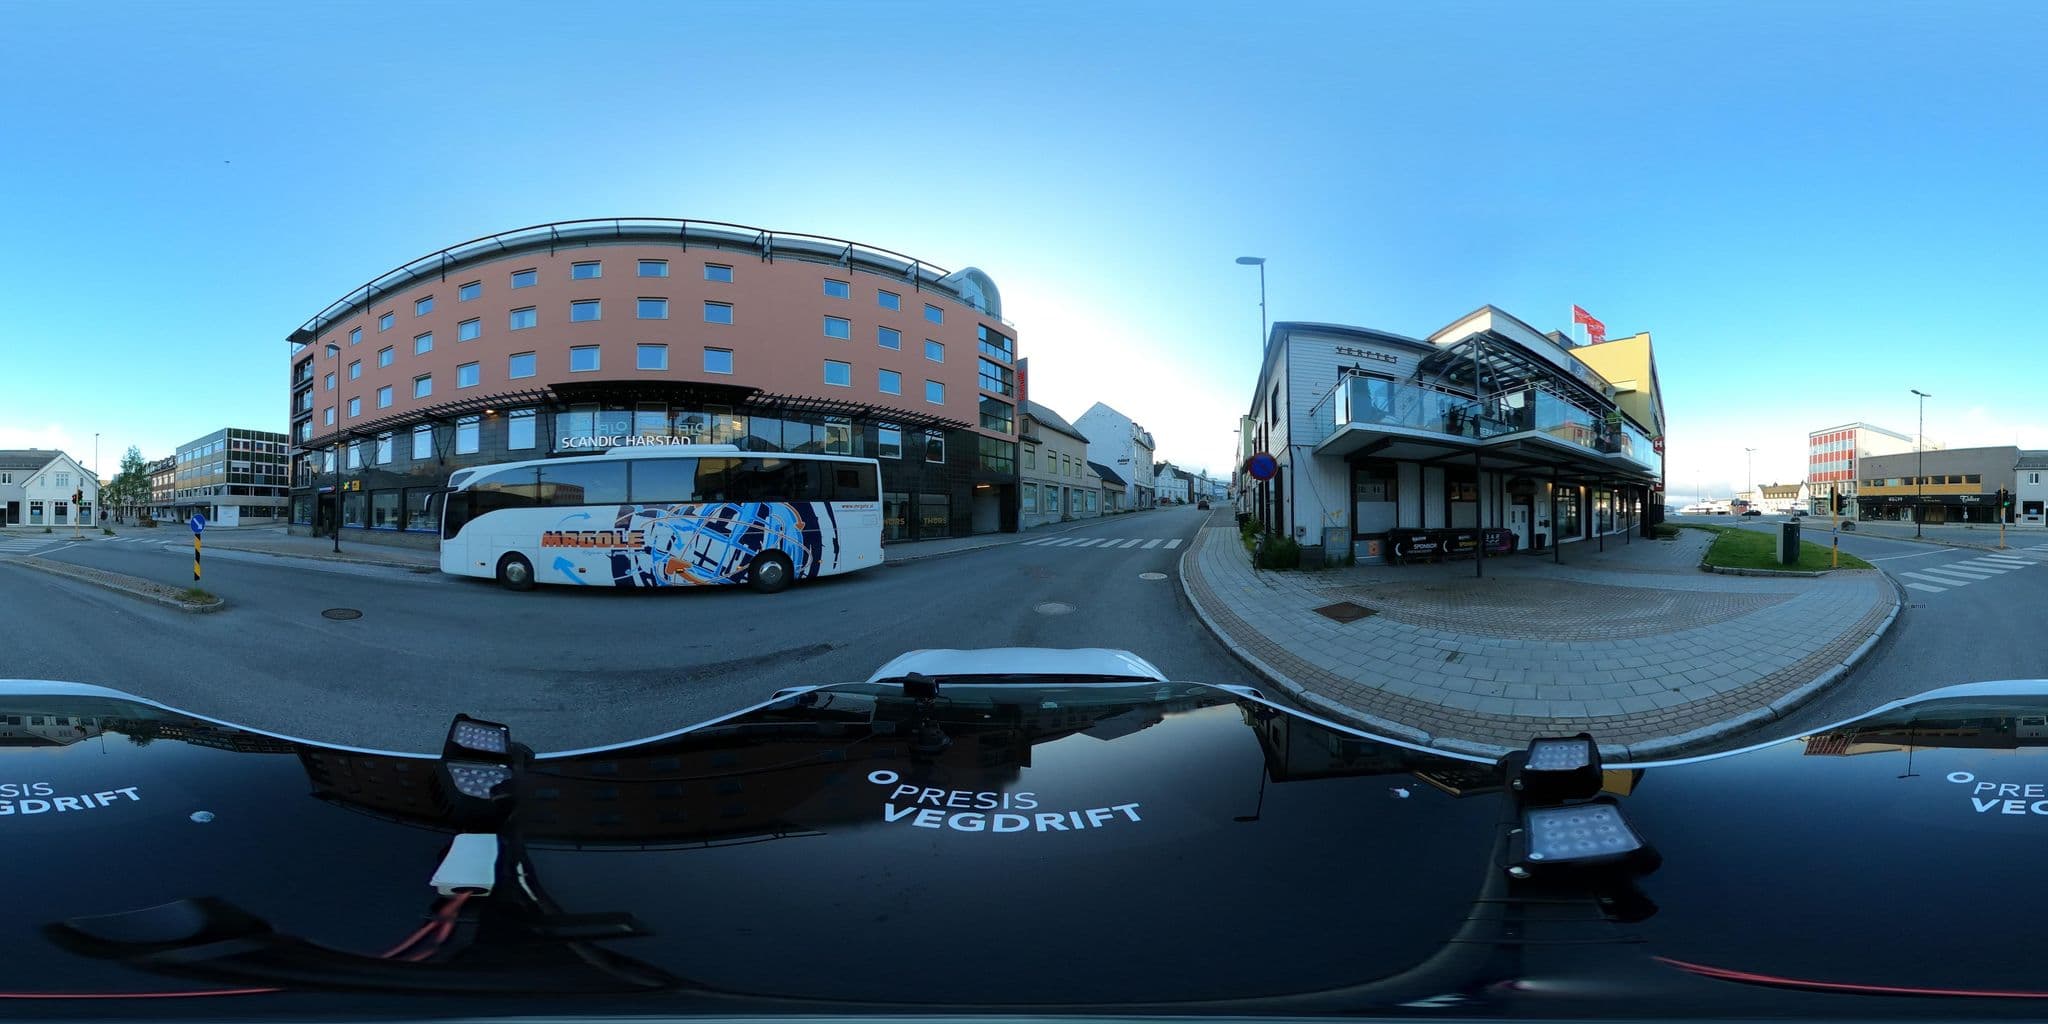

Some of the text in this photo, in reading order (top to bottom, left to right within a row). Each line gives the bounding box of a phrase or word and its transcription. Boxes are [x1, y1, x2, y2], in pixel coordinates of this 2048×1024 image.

[561, 435, 692, 449] SCANDIC HARSTAD
[890, 784, 1039, 809] PRESIS
[884, 803, 1143, 833] VEGDRIFT
